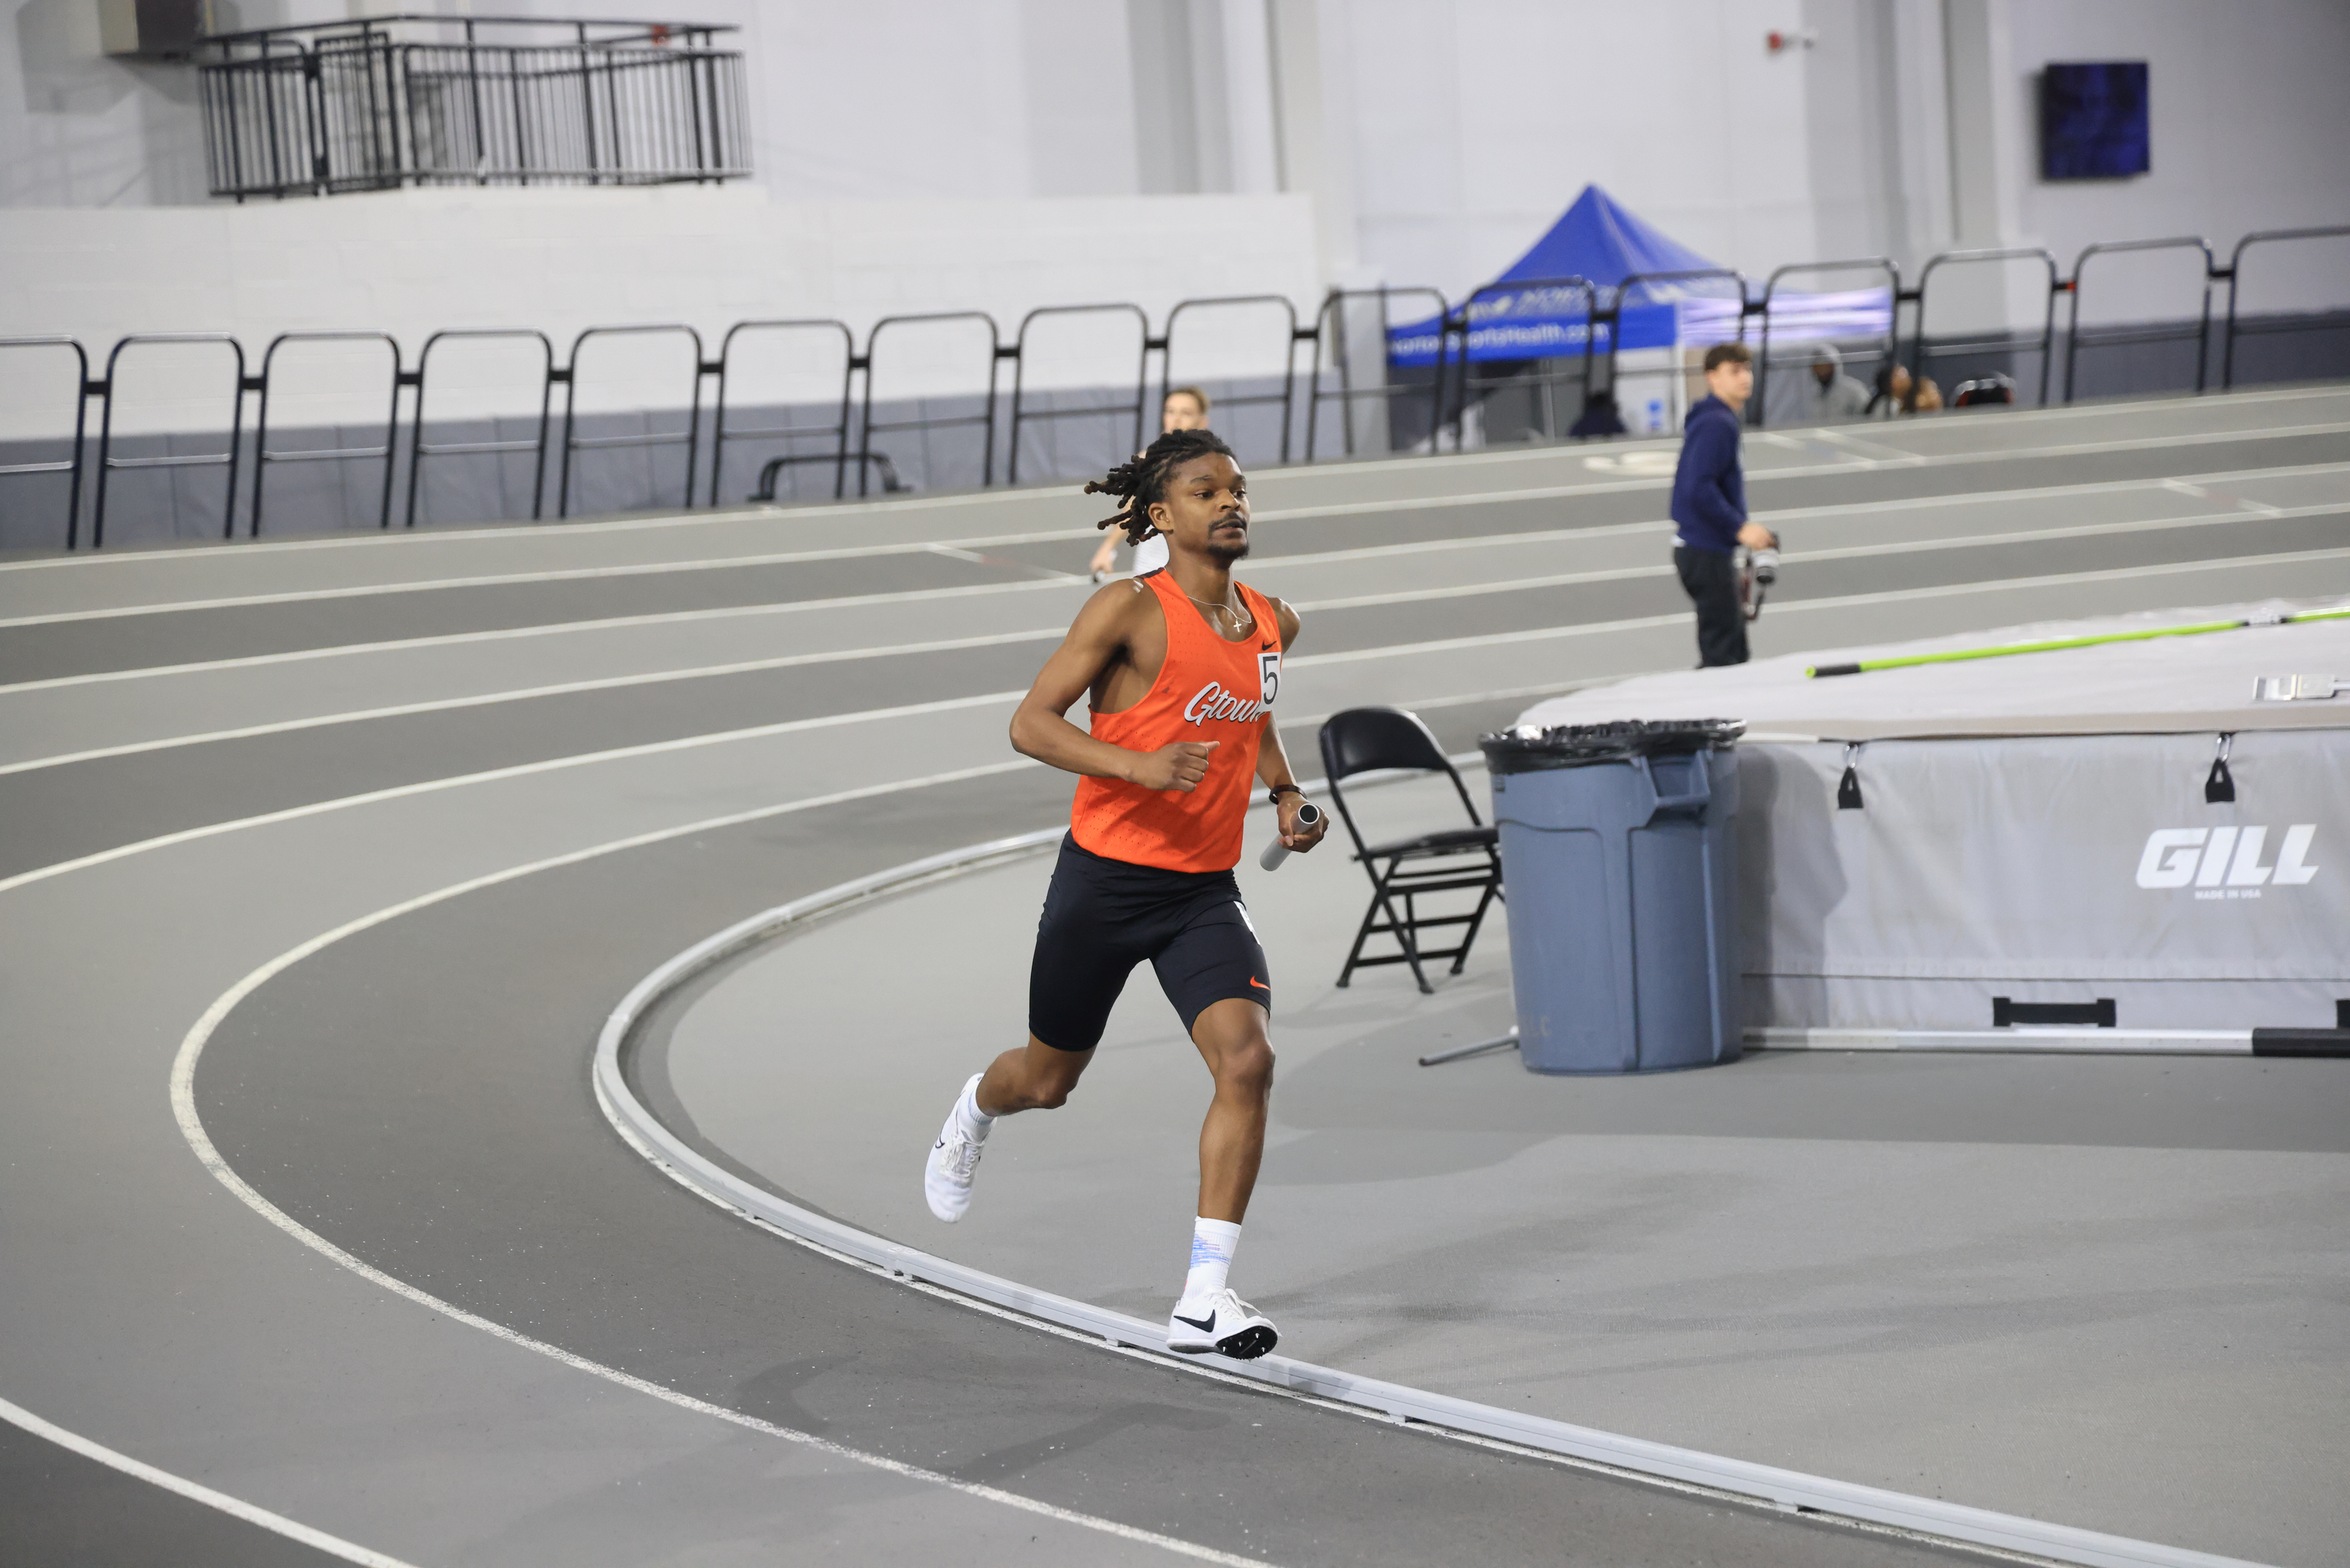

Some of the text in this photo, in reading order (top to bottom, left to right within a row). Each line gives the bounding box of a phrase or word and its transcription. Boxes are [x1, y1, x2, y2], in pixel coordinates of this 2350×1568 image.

[1262, 655, 1278, 705] 5
[2135, 823, 2320, 889] GILL
[2194, 888, 2261, 900] MADE IN USA
